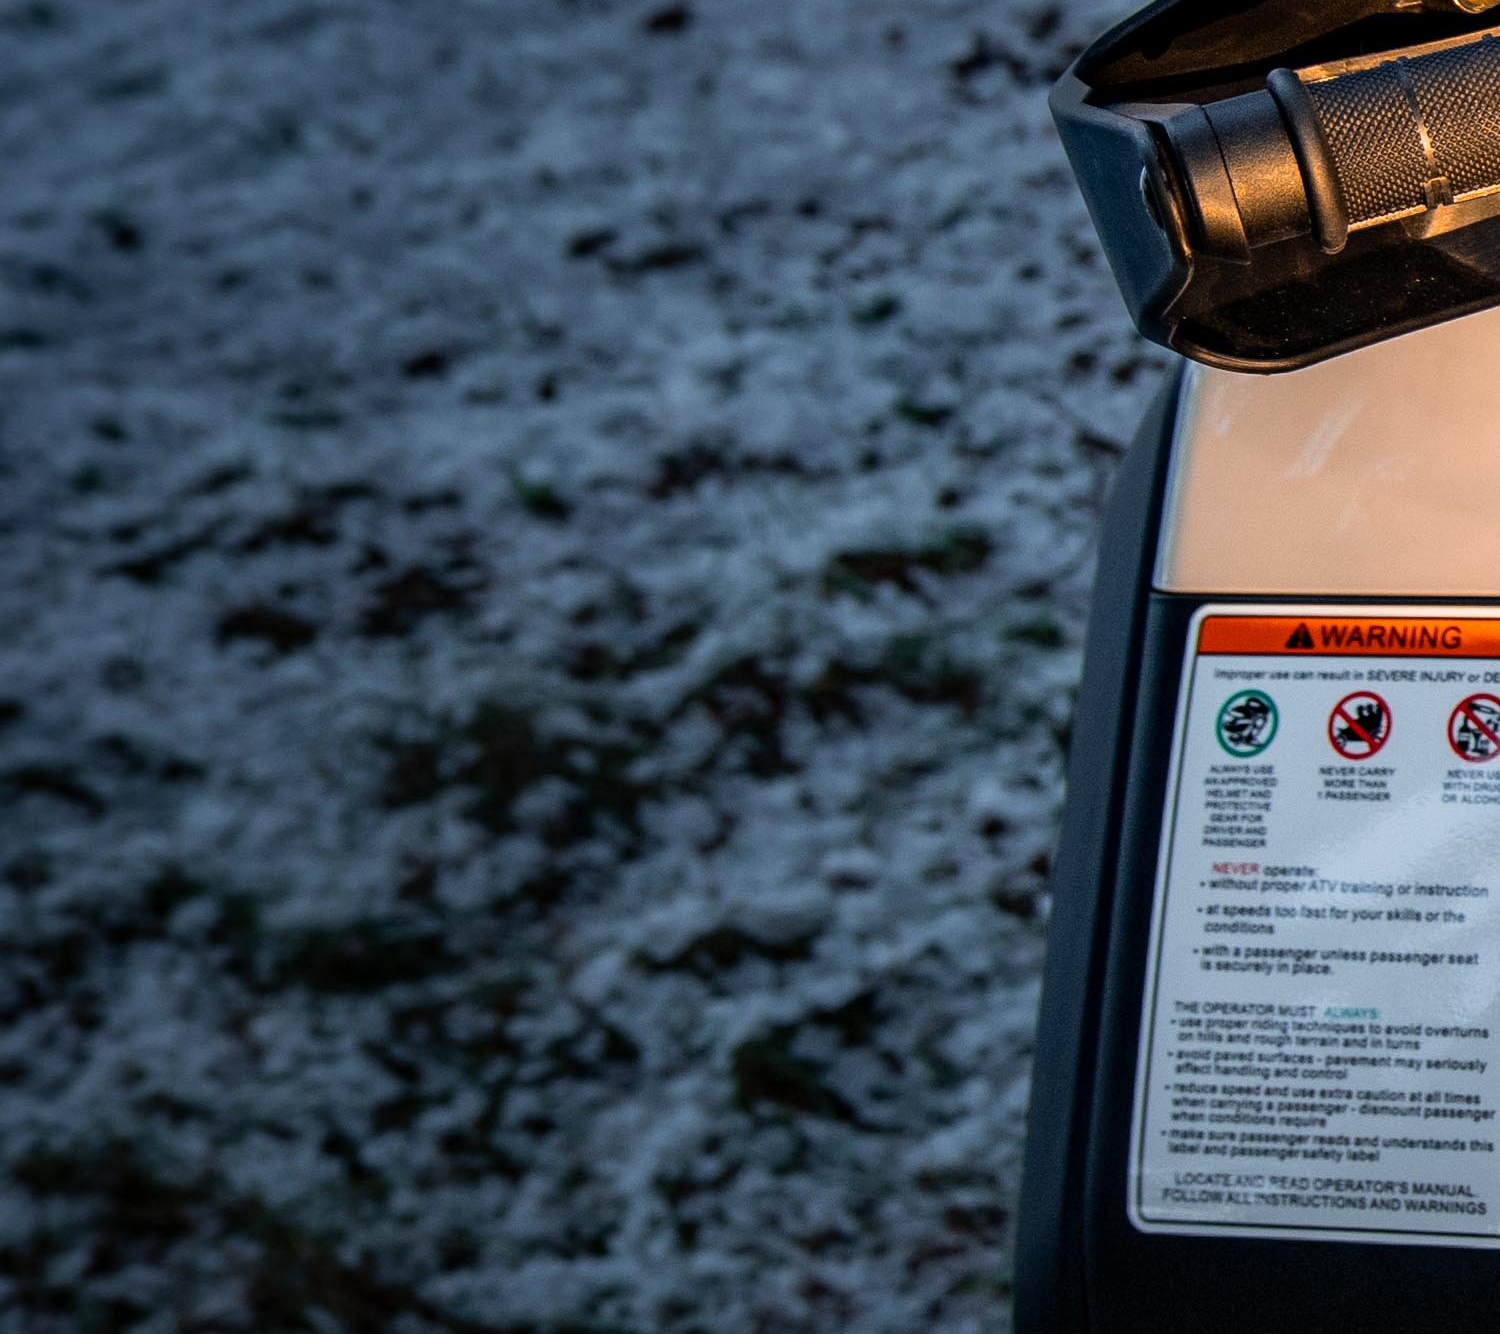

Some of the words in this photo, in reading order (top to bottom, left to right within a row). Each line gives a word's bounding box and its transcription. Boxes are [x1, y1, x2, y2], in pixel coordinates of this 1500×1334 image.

[1321, 625, 1462, 649] WARNING
[1214, 667, 1267, 682] Improper
[1270, 671, 1290, 680] use
[1293, 671, 1315, 681] can
[1319, 670, 1350, 681] result
[1352, 670, 1364, 681] in
[1367, 670, 1417, 682] SEVERE
[1420, 671, 1465, 683] INJURY
[1468, 674, 1481, 683] or
[1319, 767, 1358, 777] NEVER
[1361, 767, 1395, 777] CARRY
[1448, 770, 1484, 780] NEVER
[1324, 779, 1356, 789] MORE
[1358, 780, 1387, 790] THAN
[1443, 782, 1471, 792] WITH
[1325, 791, 1391, 802] PASSENGER
[1442, 794, 1457, 804] OR
[1209, 879, 1258, 891] without
[1260, 881, 1304, 893] proper
[1308, 882, 1338, 893] ATV
[1341, 883, 1393, 897] training
[1398, 886, 1411, 895] or
[1414, 884, 1489, 898] instruction
[1175, 1173, 1232, 1187] LOCATE
[1313, 1179, 1408, 1195] OPERATOR'S
